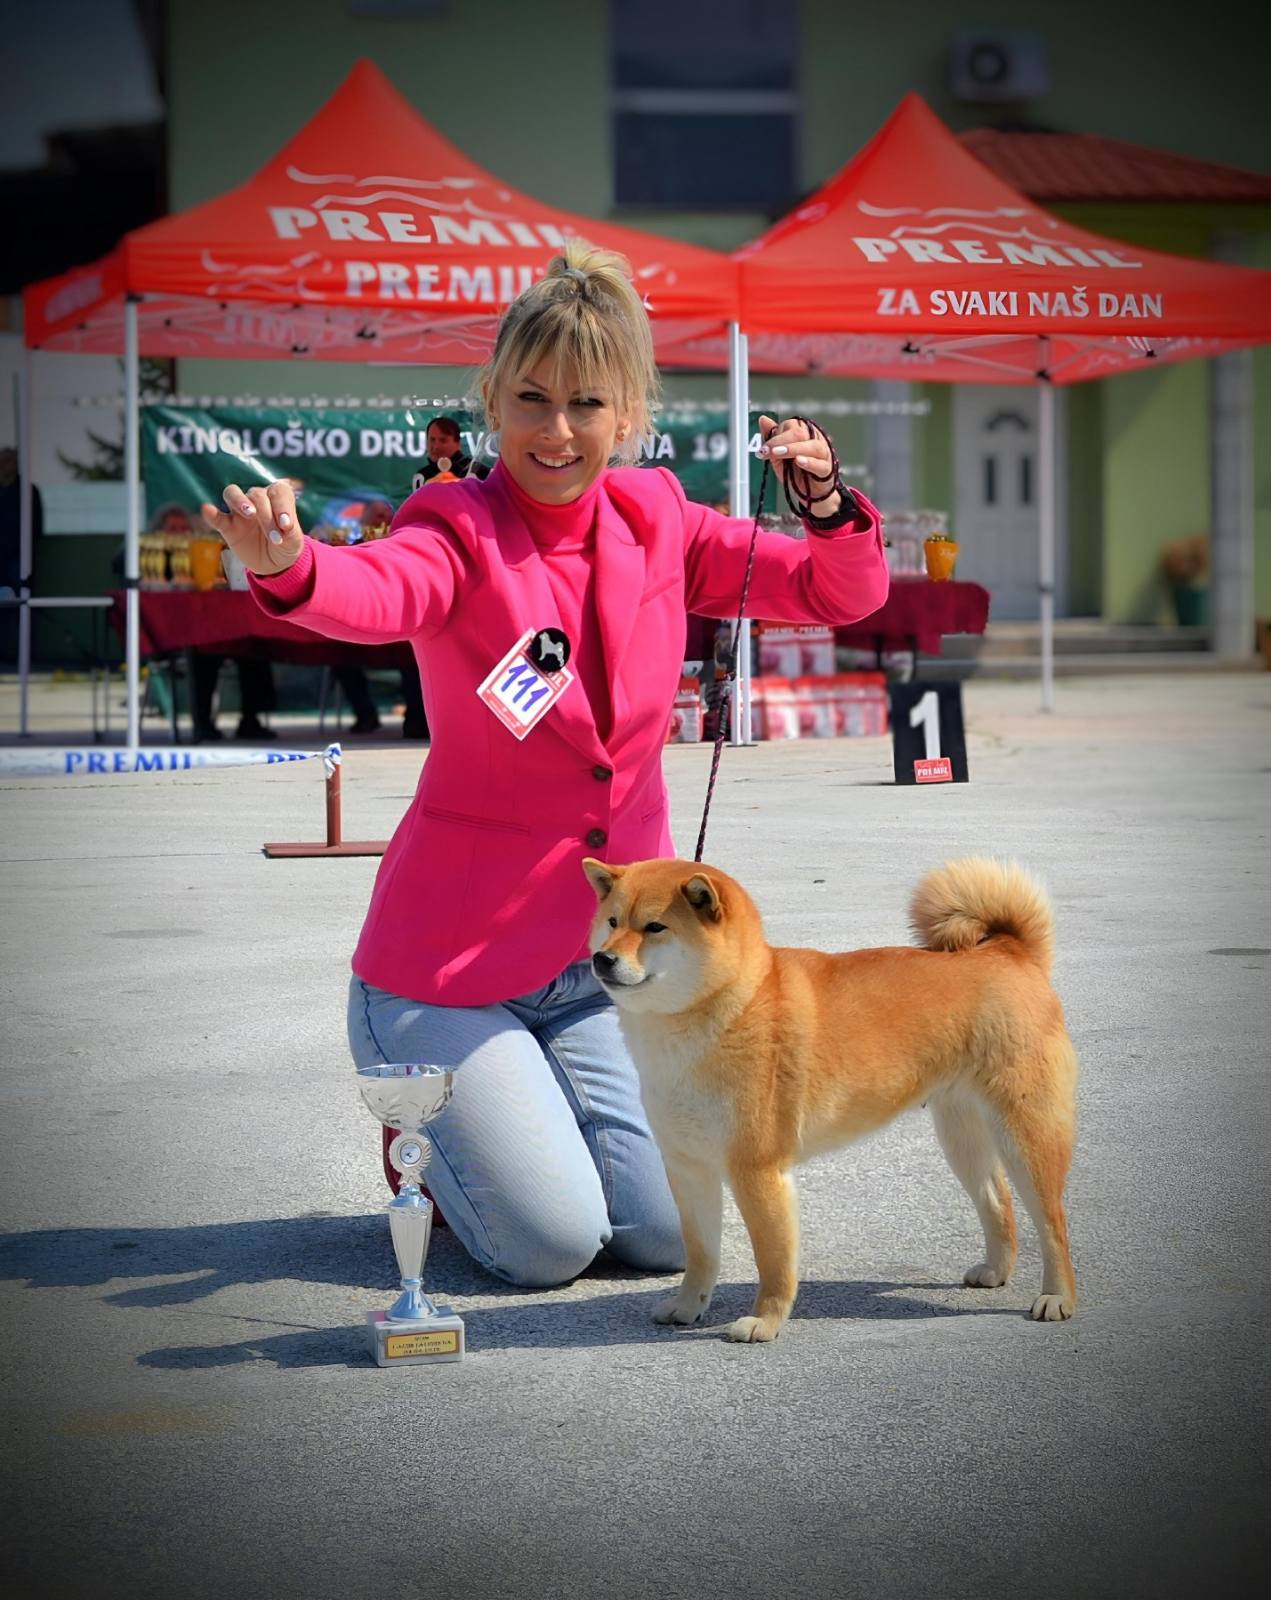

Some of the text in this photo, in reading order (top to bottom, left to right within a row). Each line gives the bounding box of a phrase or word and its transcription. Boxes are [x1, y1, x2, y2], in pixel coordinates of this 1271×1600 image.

[852, 237, 1143, 268] PREMIL
[876, 285, 1163, 318] ZA SVAKI NAŠ DAN
[157, 420, 350, 458] KINOLOŠKO
[360, 429, 500, 458] DRUVO
[692, 432, 763, 460] 194
[501, 664, 549, 712] 111
[910, 690, 940, 760] 1
